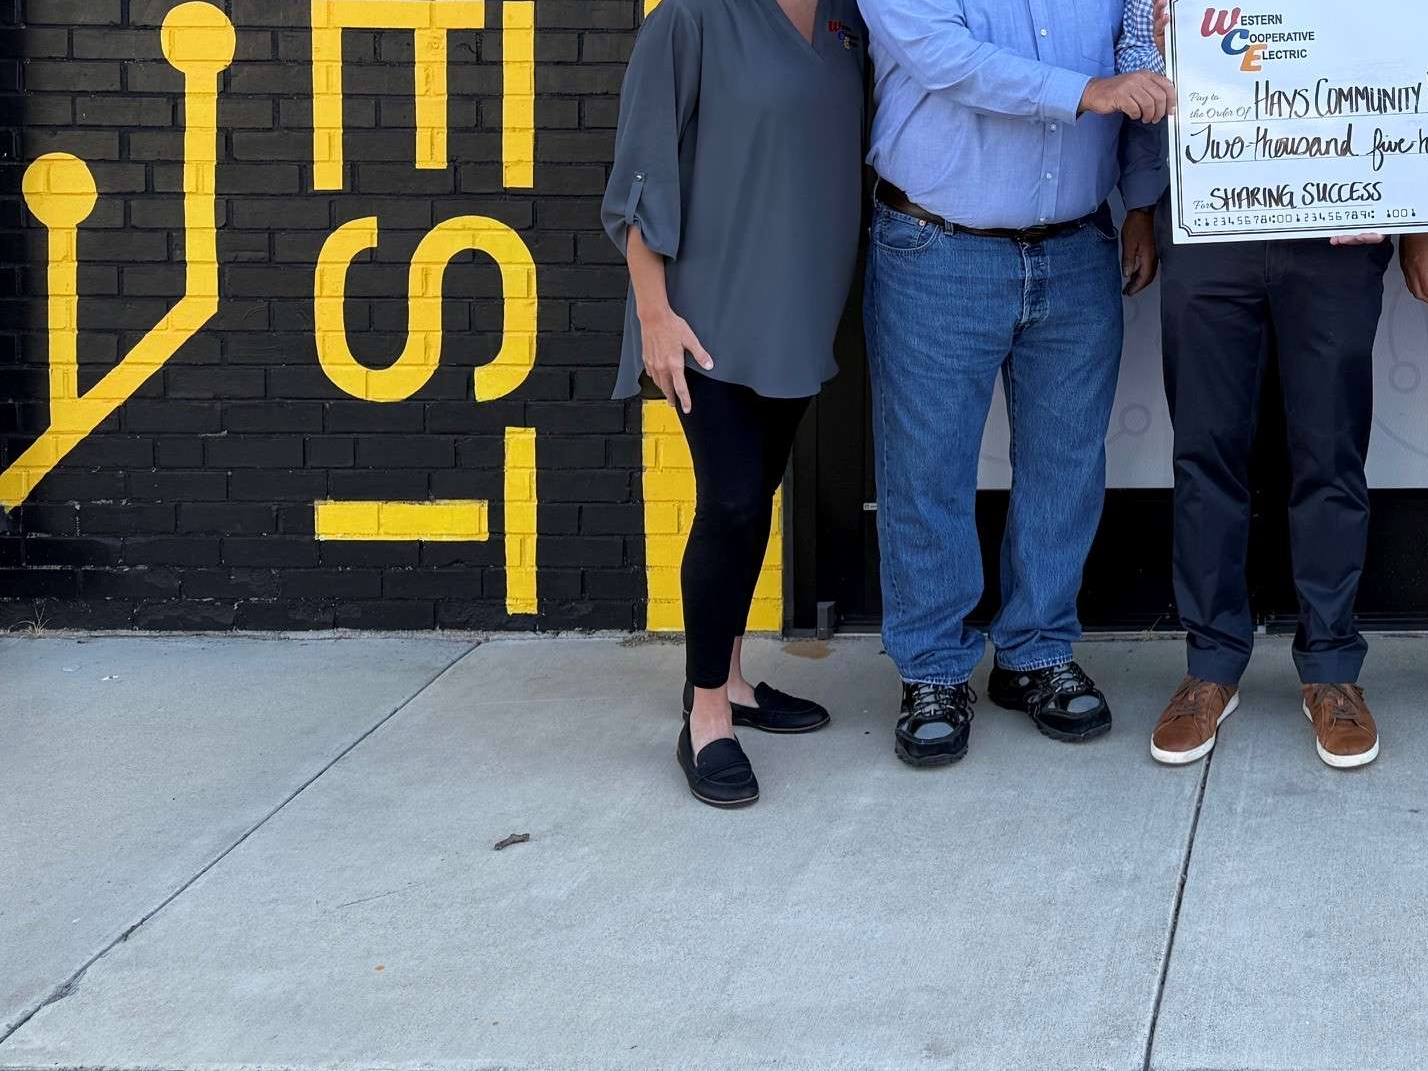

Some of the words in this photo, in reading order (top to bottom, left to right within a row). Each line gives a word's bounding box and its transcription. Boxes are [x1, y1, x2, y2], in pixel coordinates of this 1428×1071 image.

[1200, 7, 1283, 38] WESTERN
[1220, 28, 1315, 56] COOPERATIVE
[1239, 44, 1308, 72] ELECTRIC
[1189, 92, 1209, 105] Pay
[1211, 93, 1220, 101] to
[1314, 78, 1422, 117] COMMUNITY
[1189, 108, 1205, 119] the
[1206, 107, 1233, 119] Order
[1236, 106, 1252, 120] Of
[1210, 184, 1297, 211] SHARING
[1302, 181, 1383, 206] SUCCESS
[1386, 208, 1416, 218] 1001
